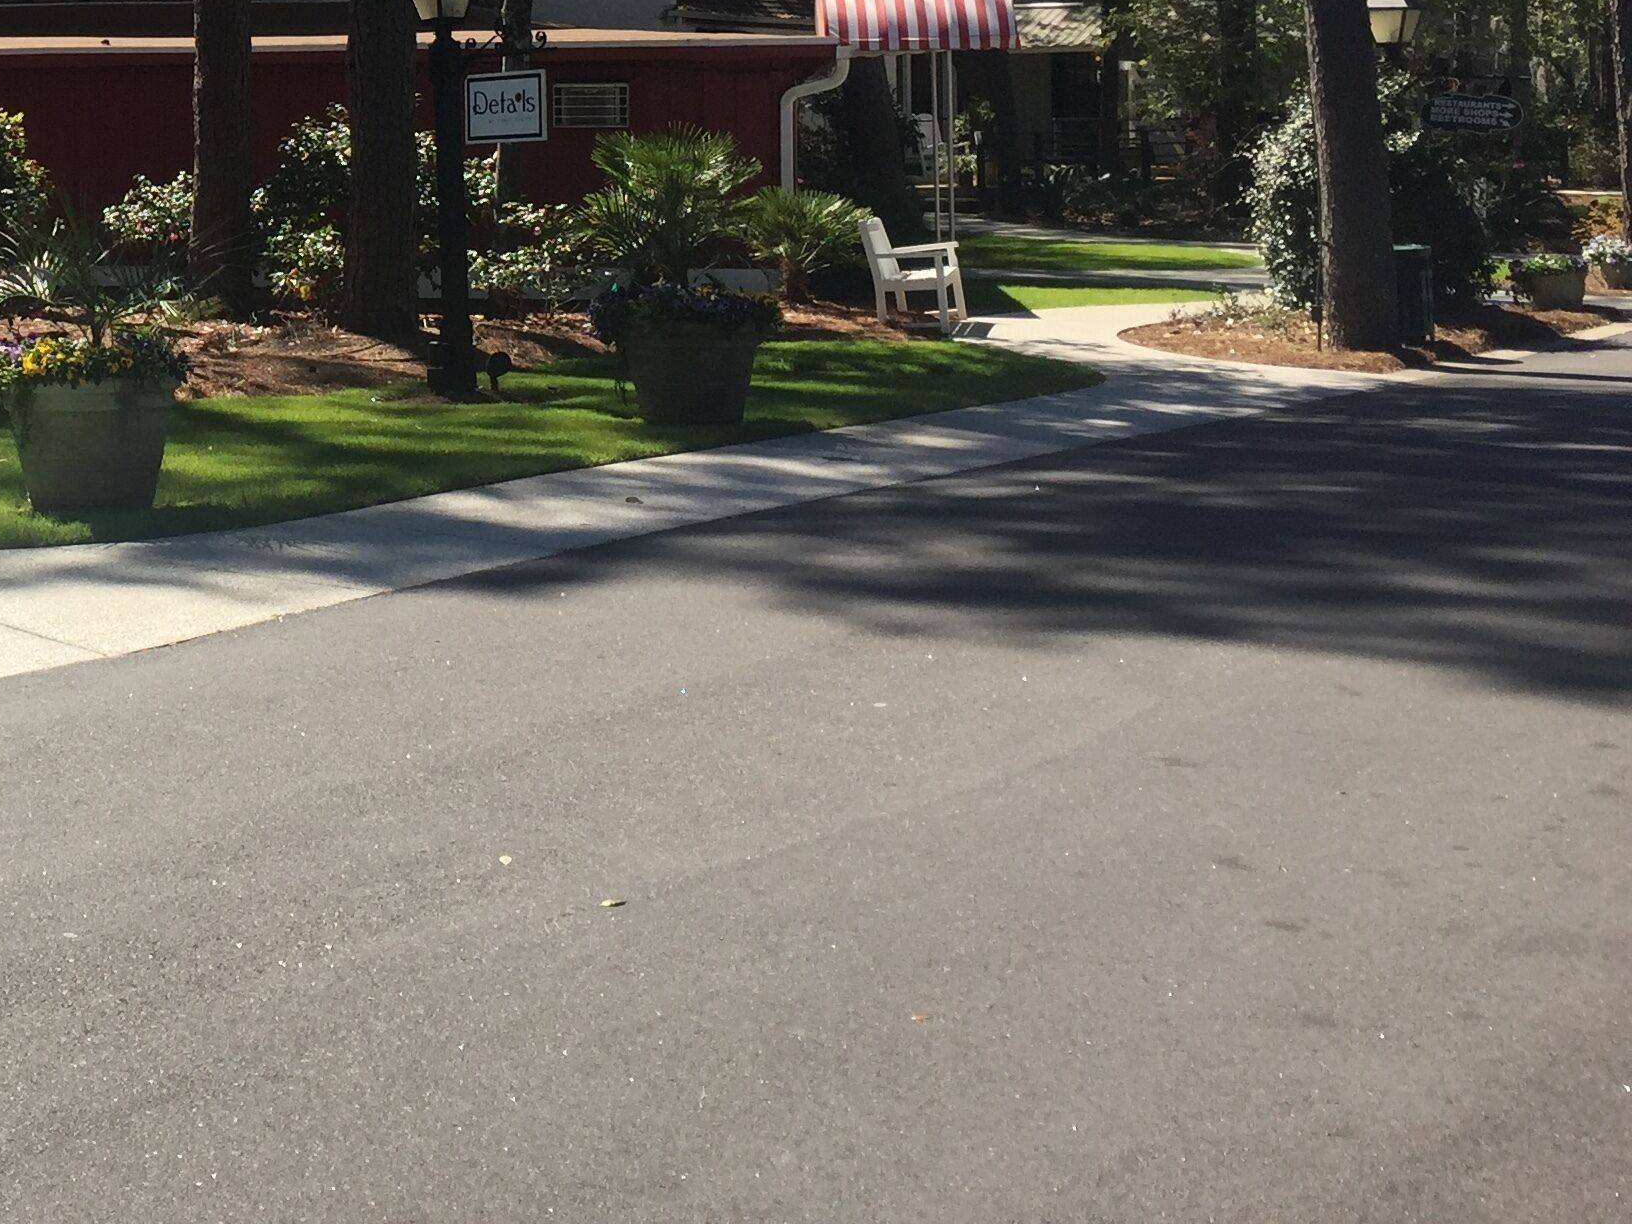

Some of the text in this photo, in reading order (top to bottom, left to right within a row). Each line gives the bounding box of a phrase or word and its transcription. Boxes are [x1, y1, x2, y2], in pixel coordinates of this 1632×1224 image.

[472, 89, 536, 115] Details
[1434, 99, 1502, 110] RESTAURANTS
[1430, 106, 1499, 118] MORE SHOPS
